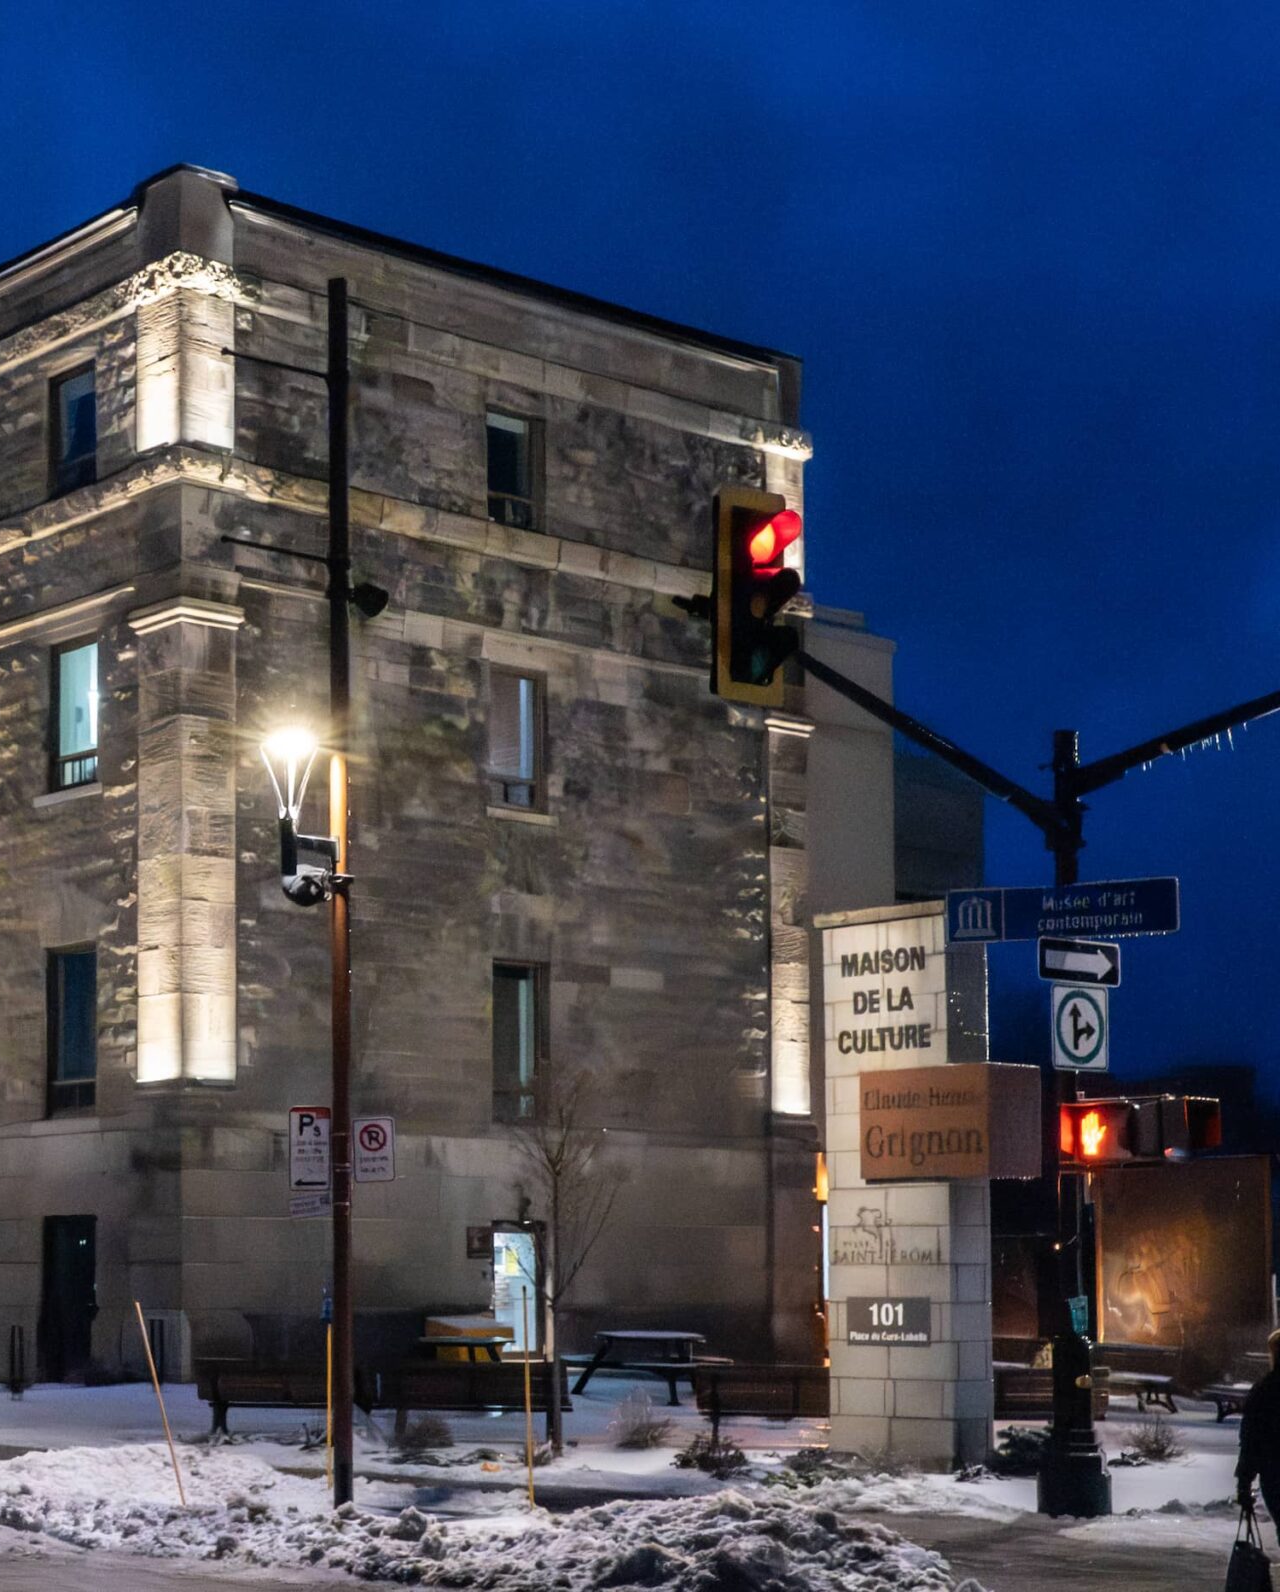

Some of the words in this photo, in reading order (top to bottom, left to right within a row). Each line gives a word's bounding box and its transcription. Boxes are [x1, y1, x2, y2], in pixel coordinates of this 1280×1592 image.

[1037, 912, 1143, 931] contemporain
[841, 946, 926, 978] MAISON
[852, 989, 881, 1015] DE
[886, 986, 914, 1012] LA
[838, 1023, 932, 1055] CULTURE
[865, 1125, 983, 1166] Grignon
[868, 1303, 904, 1327] 101
